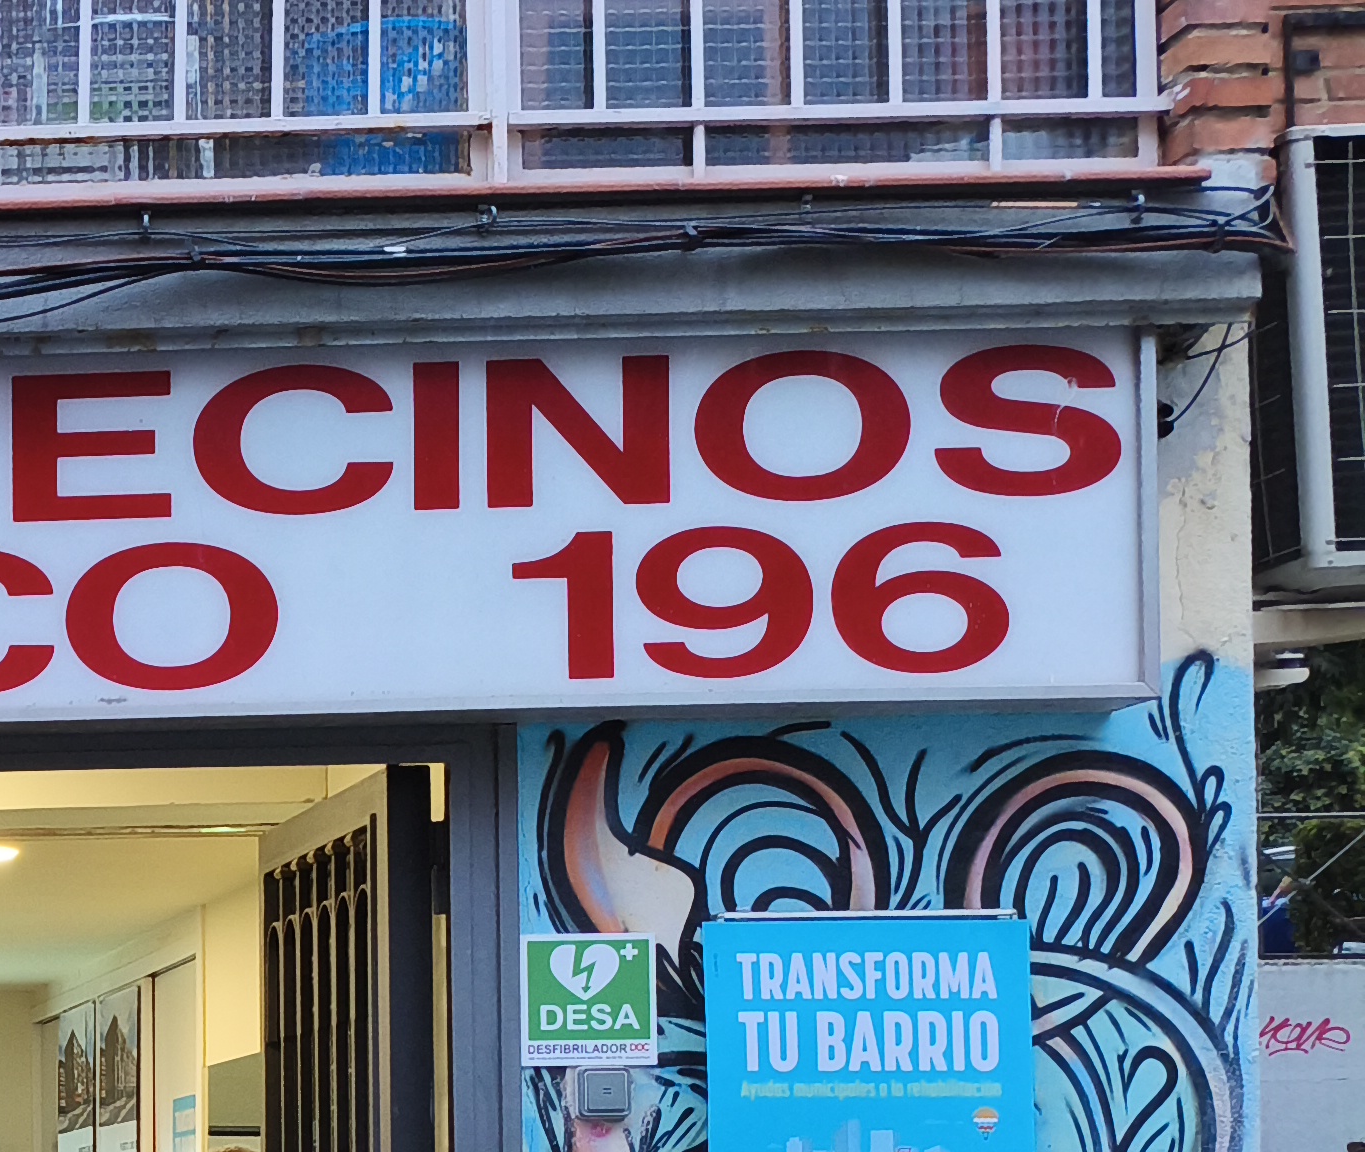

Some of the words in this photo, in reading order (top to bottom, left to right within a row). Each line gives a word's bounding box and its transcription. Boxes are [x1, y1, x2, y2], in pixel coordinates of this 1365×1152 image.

[512, 523, 1010, 680] 196
[736, 952, 997, 999] TRANSFORMA
[540, 1004, 640, 1031] DESA
[528, 1044, 627, 1054] DESFIBRILADOR
[738, 1010, 799, 1072] TU
[816, 1010, 1000, 1072] BARRIO
[740, 1080, 790, 1100] Ayudas
[793, 1080, 875, 1100] municipales
